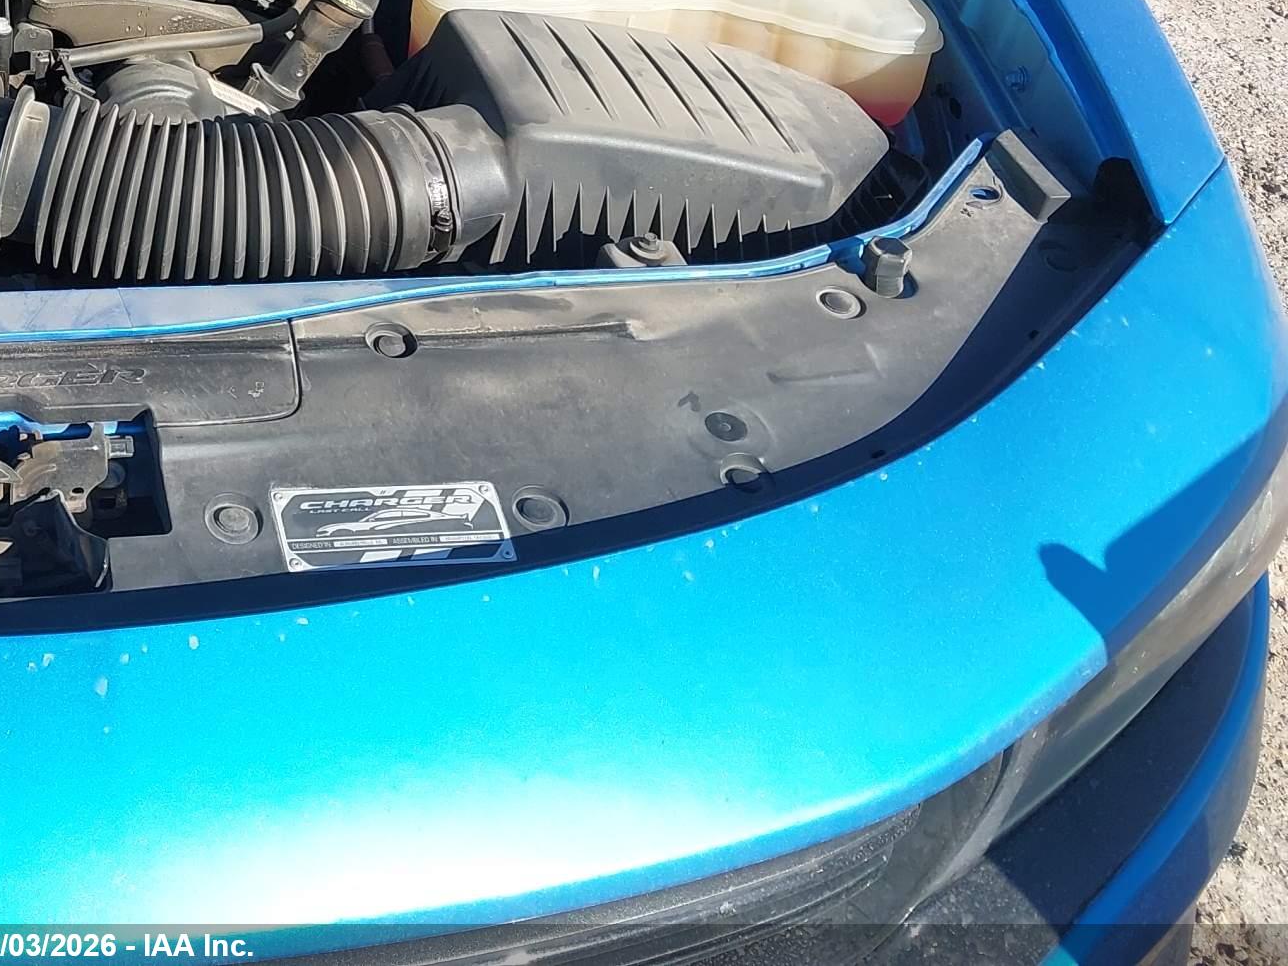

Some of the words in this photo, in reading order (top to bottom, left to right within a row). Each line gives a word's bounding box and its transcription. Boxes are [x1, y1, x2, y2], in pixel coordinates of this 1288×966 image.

[300, 495, 479, 510] CHARGER
[291, 542, 323, 550] DESIGNED
[392, 536, 430, 545] ASSEMBLED
